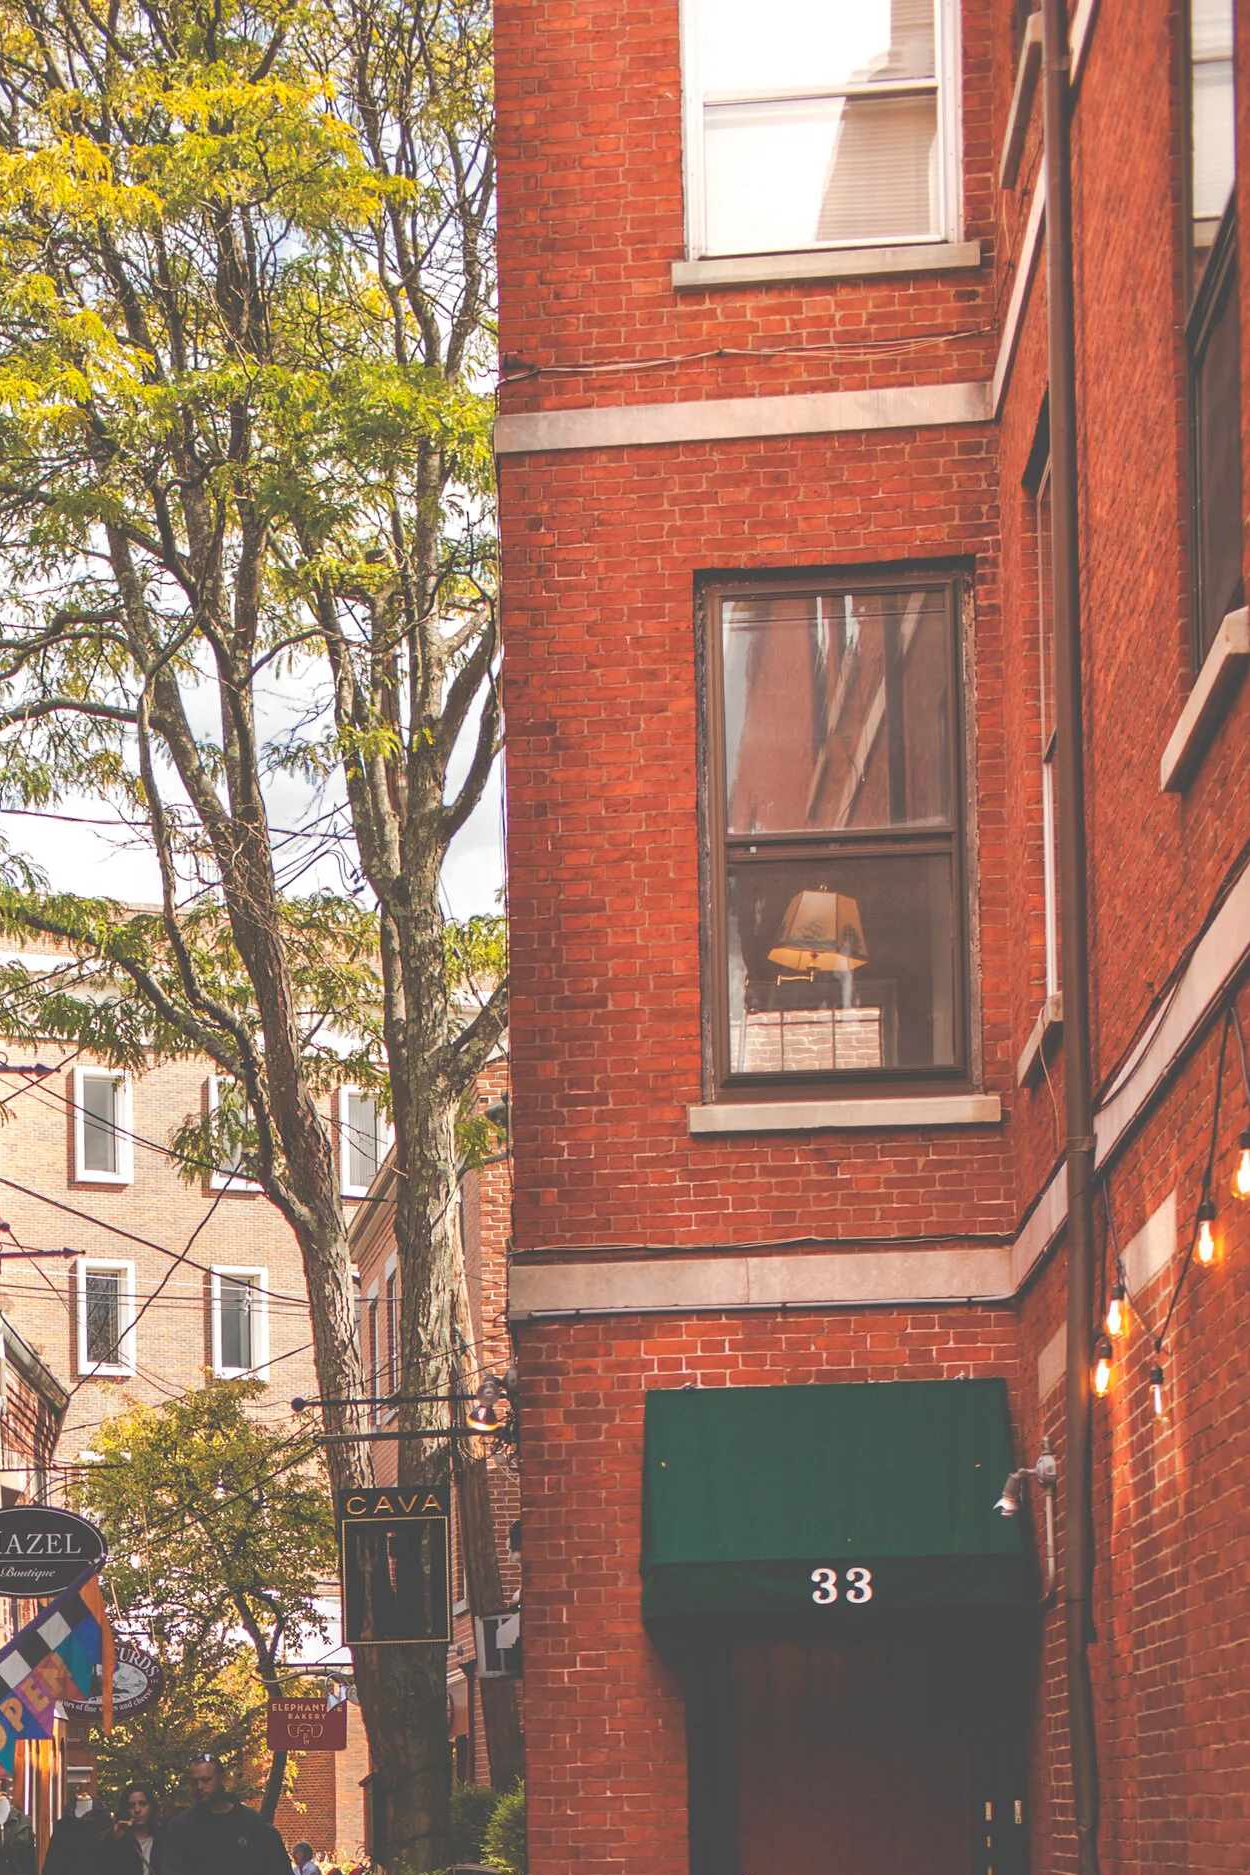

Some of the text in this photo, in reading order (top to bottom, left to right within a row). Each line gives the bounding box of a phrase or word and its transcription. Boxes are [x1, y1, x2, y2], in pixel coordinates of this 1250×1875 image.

[346, 1493, 442, 1515] CAVA
[0, 1566, 56, 1581] Boutique
[810, 1566, 873, 1605] 33
[115, 1647, 160, 1677] URDS
[76, 1703, 84, 1711] of
[120, 1701, 133, 1710] and
[133, 1688, 153, 1706] cheese
[272, 1703, 343, 1712] ELEPHANTE
